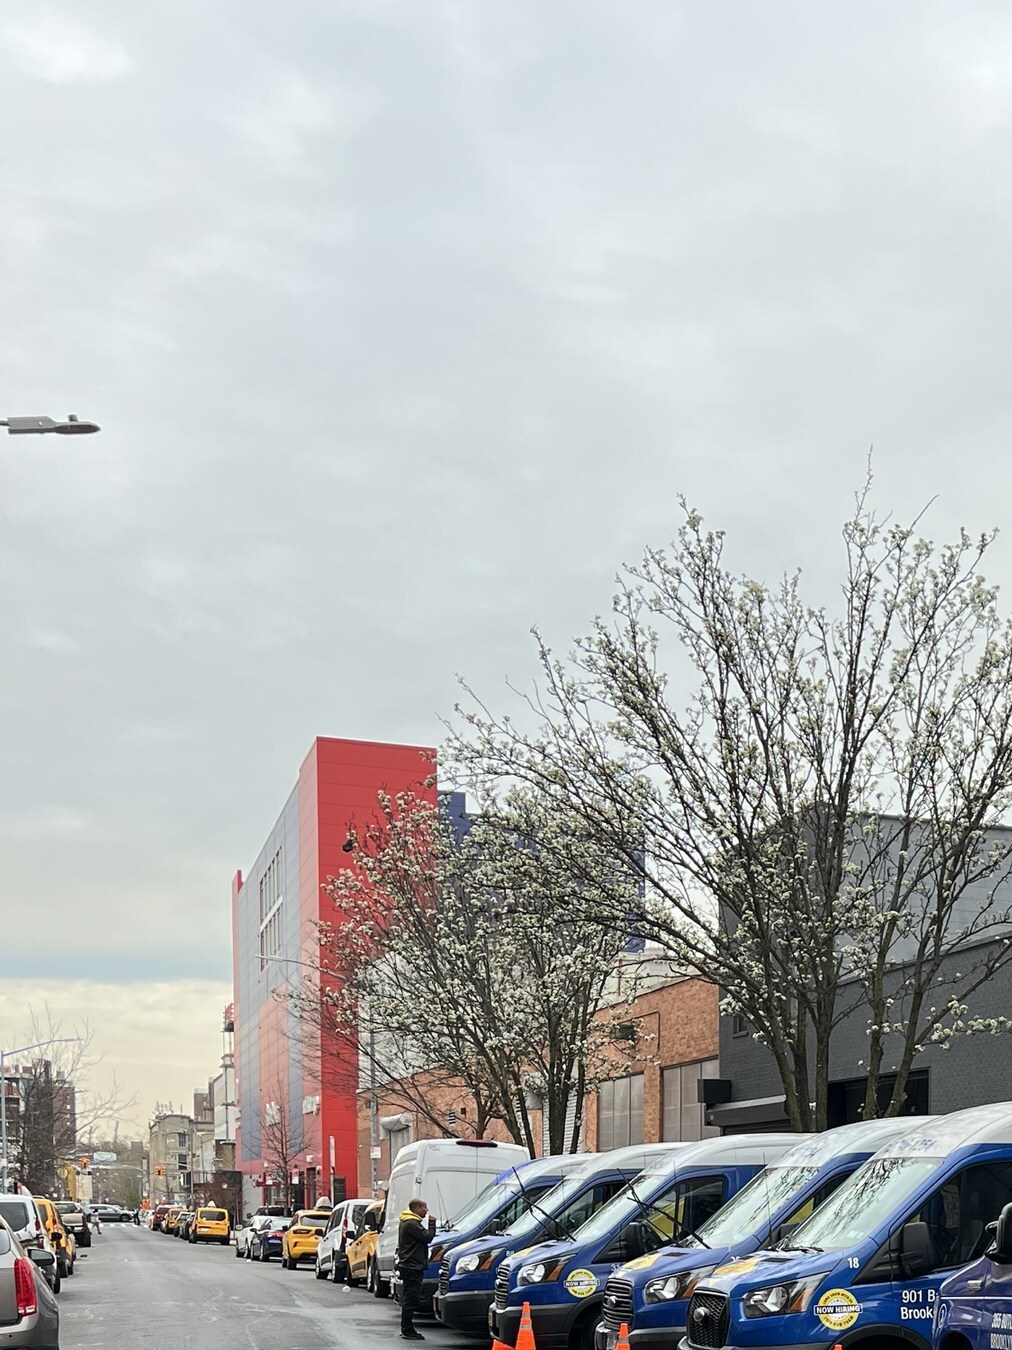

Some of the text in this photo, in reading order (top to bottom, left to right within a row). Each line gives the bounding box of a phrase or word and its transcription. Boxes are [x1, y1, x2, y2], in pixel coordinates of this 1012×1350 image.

[847, 1257, 860, 1269] 18
[902, 1289, 938, 1303] 901 B
[835, 1305, 861, 1313] HIRING
[900, 1305, 934, 1320] Brook
